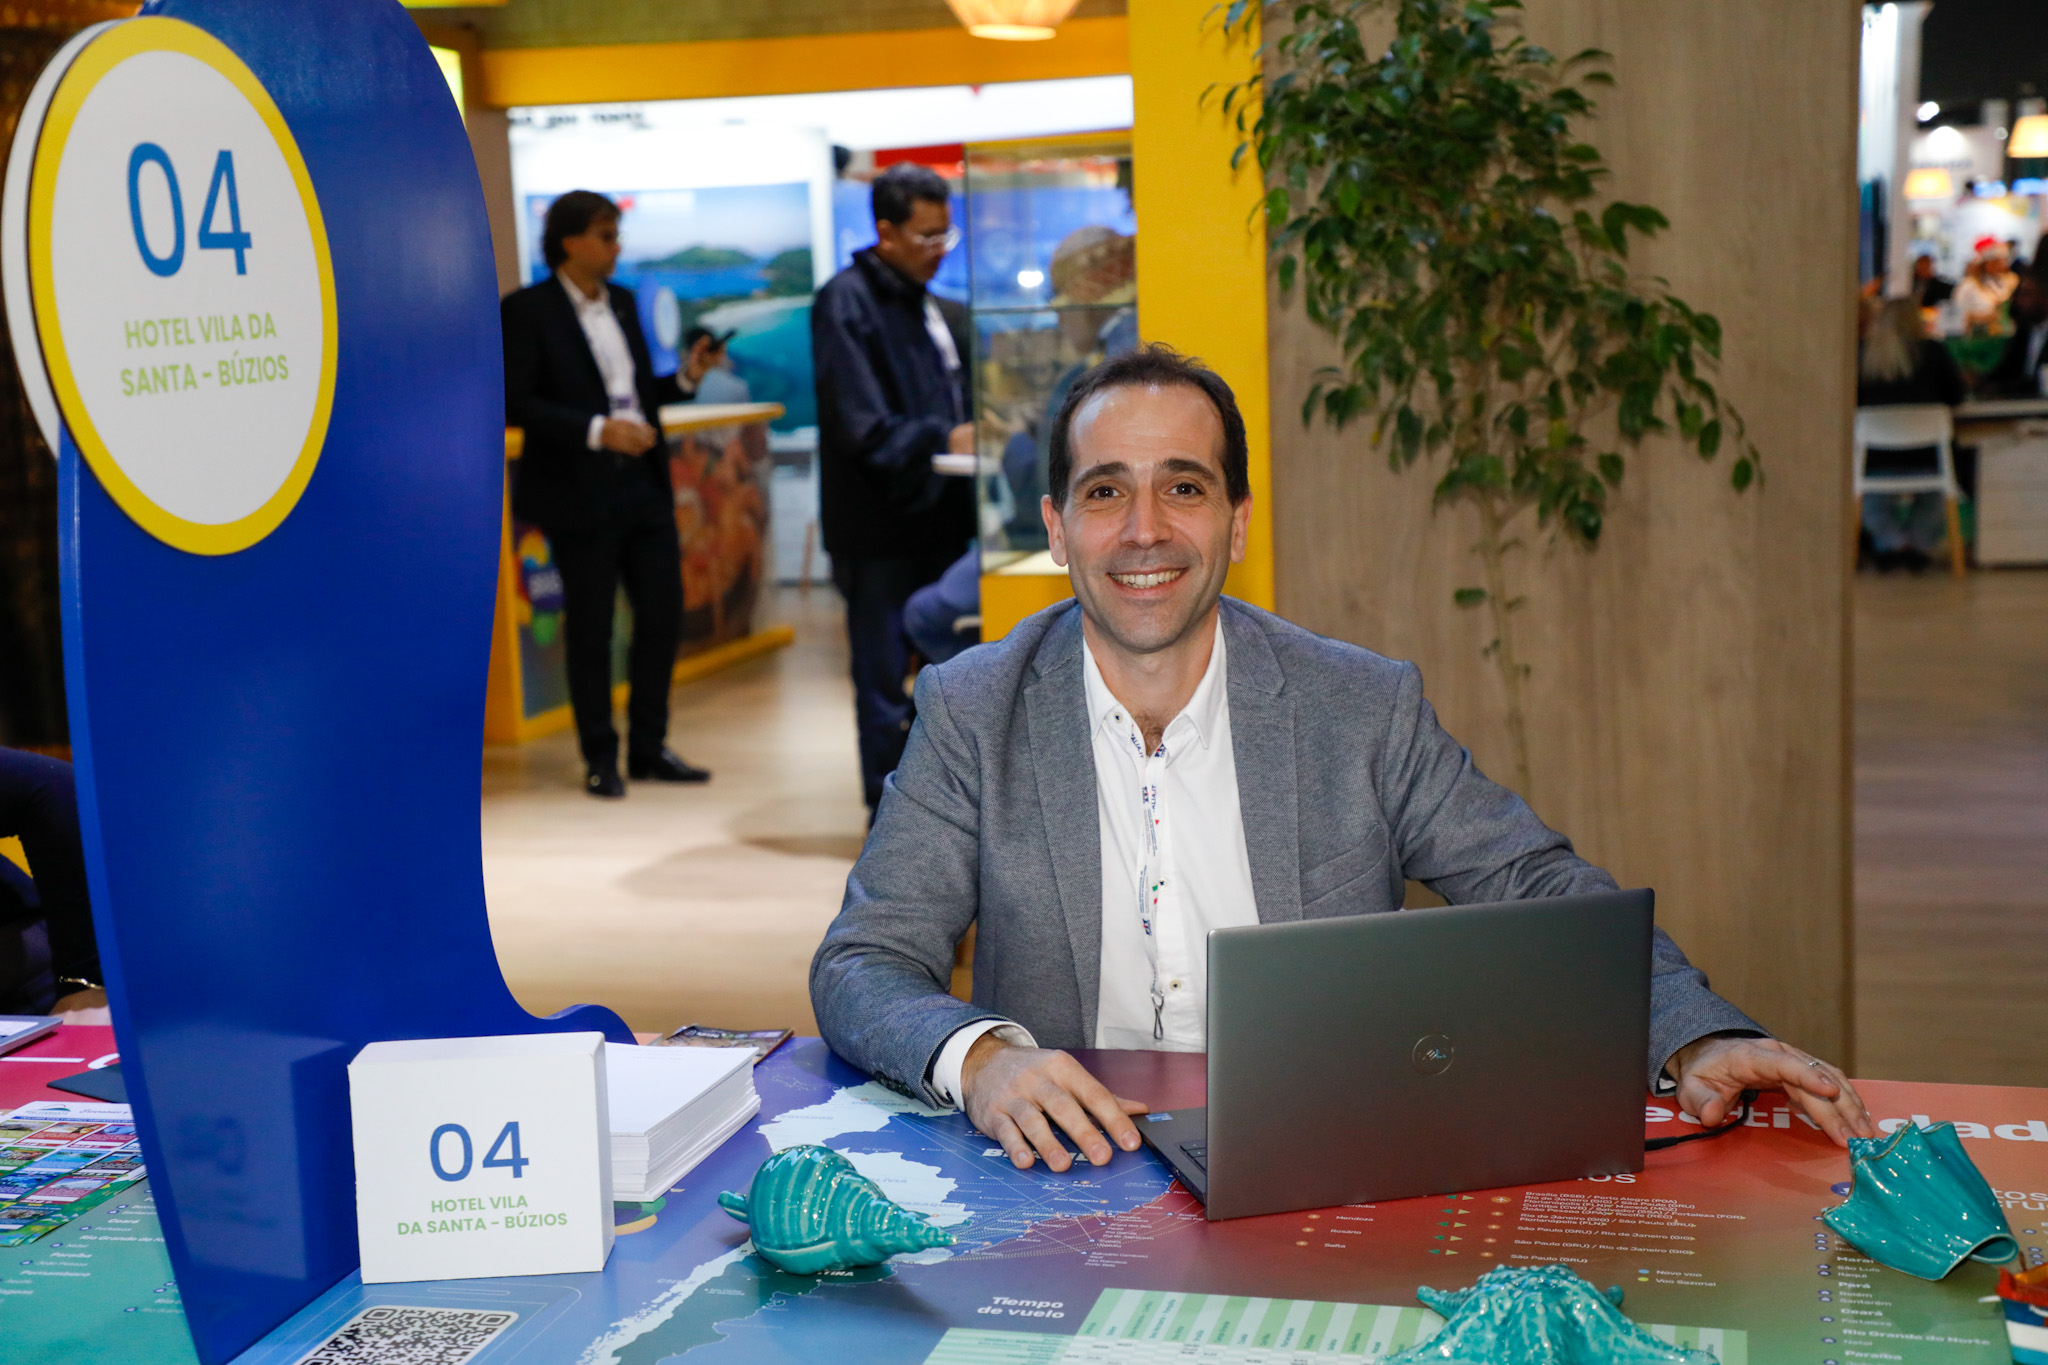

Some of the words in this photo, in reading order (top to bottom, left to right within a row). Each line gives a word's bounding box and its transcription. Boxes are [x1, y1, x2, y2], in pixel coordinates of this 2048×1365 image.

[127, 142, 253, 278] 04
[124, 317, 196, 349] HOTEL
[198, 314, 245, 343] VILA
[247, 312, 277, 340] DA
[120, 363, 198, 396] SANTA
[217, 350, 289, 387] BÚZIOS
[429, 1121, 530, 1182] 04
[431, 1198, 486, 1213] HOTEL
[489, 1195, 528, 1209] VILA
[397, 1221, 423, 1235] DA
[427, 1217, 487, 1233] SANTA
[504, 1211, 568, 1229] BÚZIOS
[977, 1305, 1003, 1315] de
[1008, 1307, 1065, 1319] vuelo
[991, 1296, 1064, 1309] Tiempo
